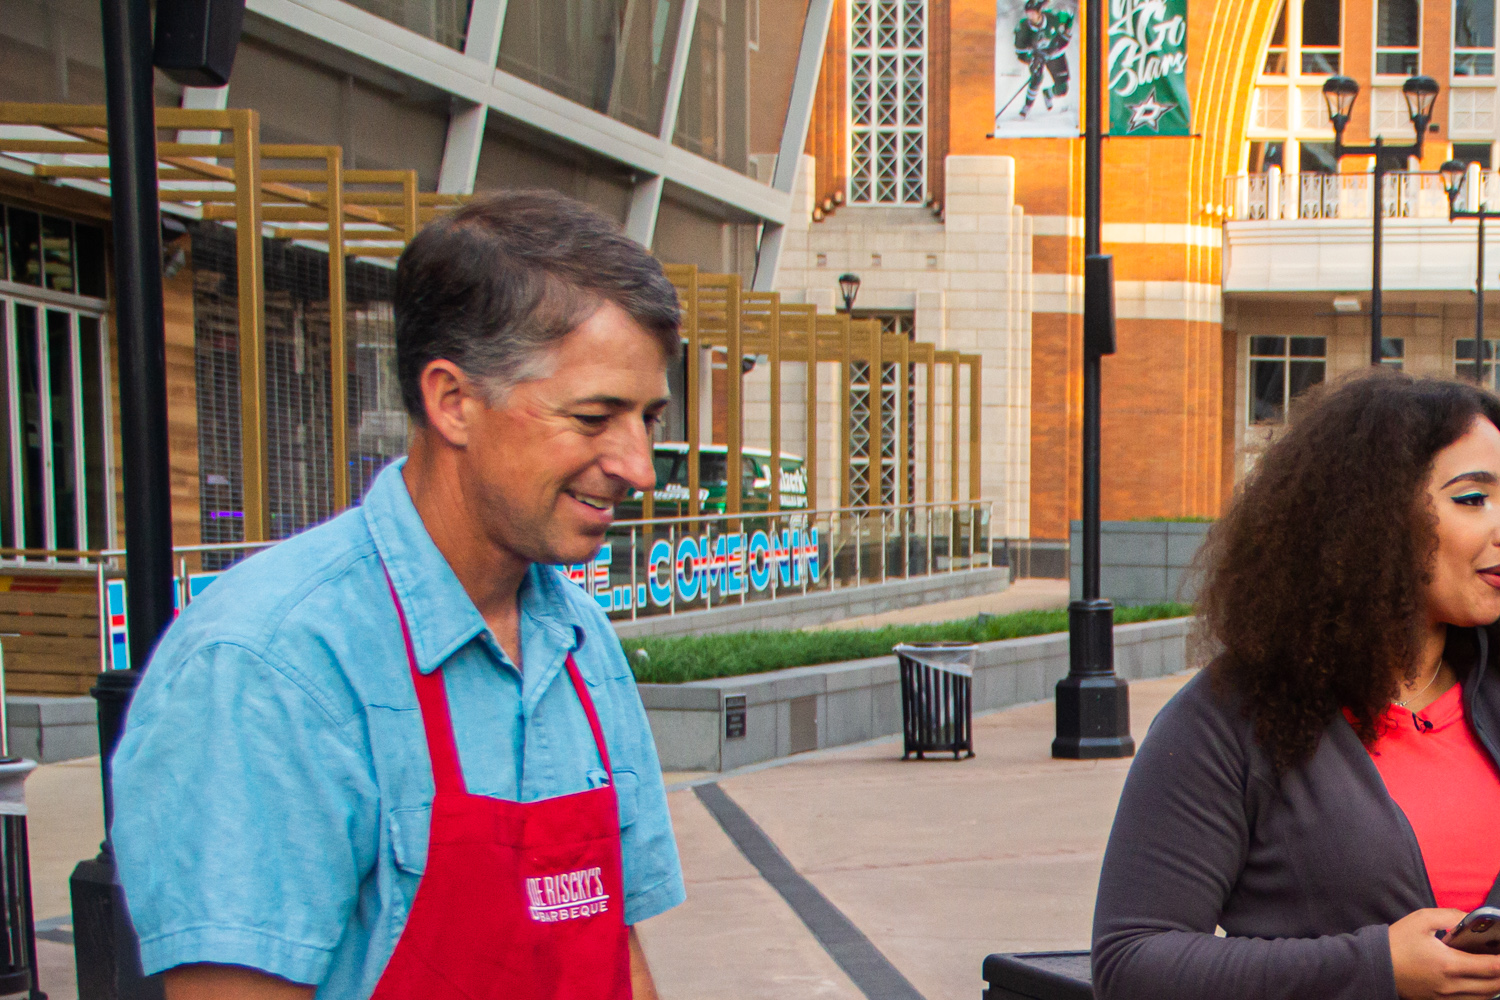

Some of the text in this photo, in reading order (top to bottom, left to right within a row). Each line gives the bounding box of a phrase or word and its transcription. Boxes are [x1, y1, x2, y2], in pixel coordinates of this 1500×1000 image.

[1108, 36, 1188, 97] Stars
[543, 866, 604, 907] RISCKY'S
[540, 900, 609, 922] BARBEQUE
